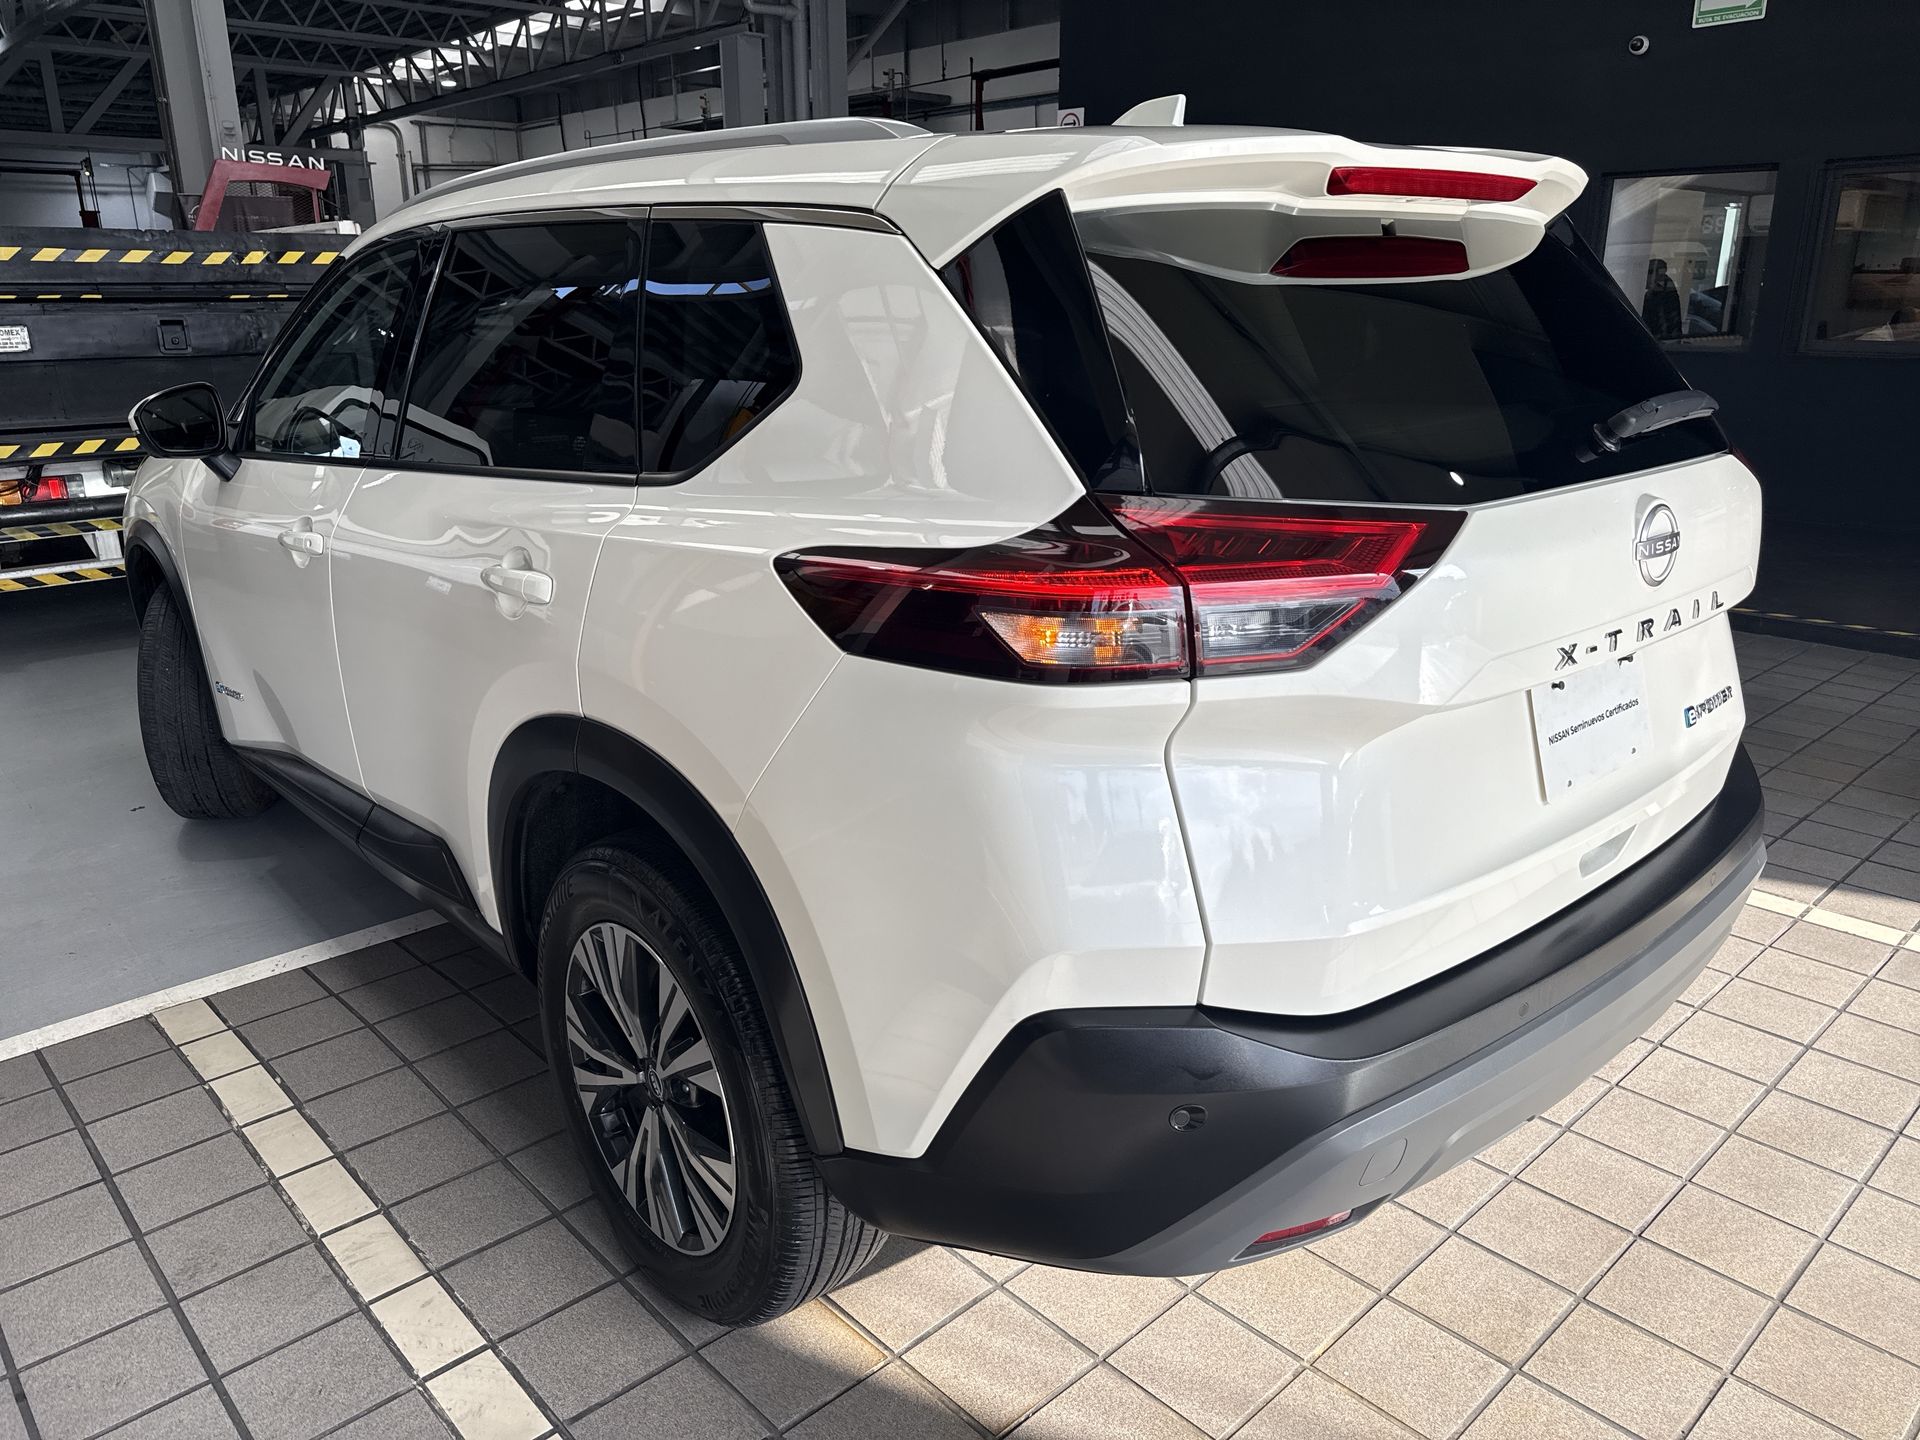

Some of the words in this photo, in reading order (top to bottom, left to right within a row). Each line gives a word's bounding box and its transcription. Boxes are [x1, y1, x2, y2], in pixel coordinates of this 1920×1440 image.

[221, 146, 325, 171] NISSAN
[1554, 590, 1724, 671] X-TRAIL
[1548, 727, 1570, 746] NISSAN
[1570, 713, 1605, 736] Seminuevos
[1605, 698, 1639, 719] Certificados
